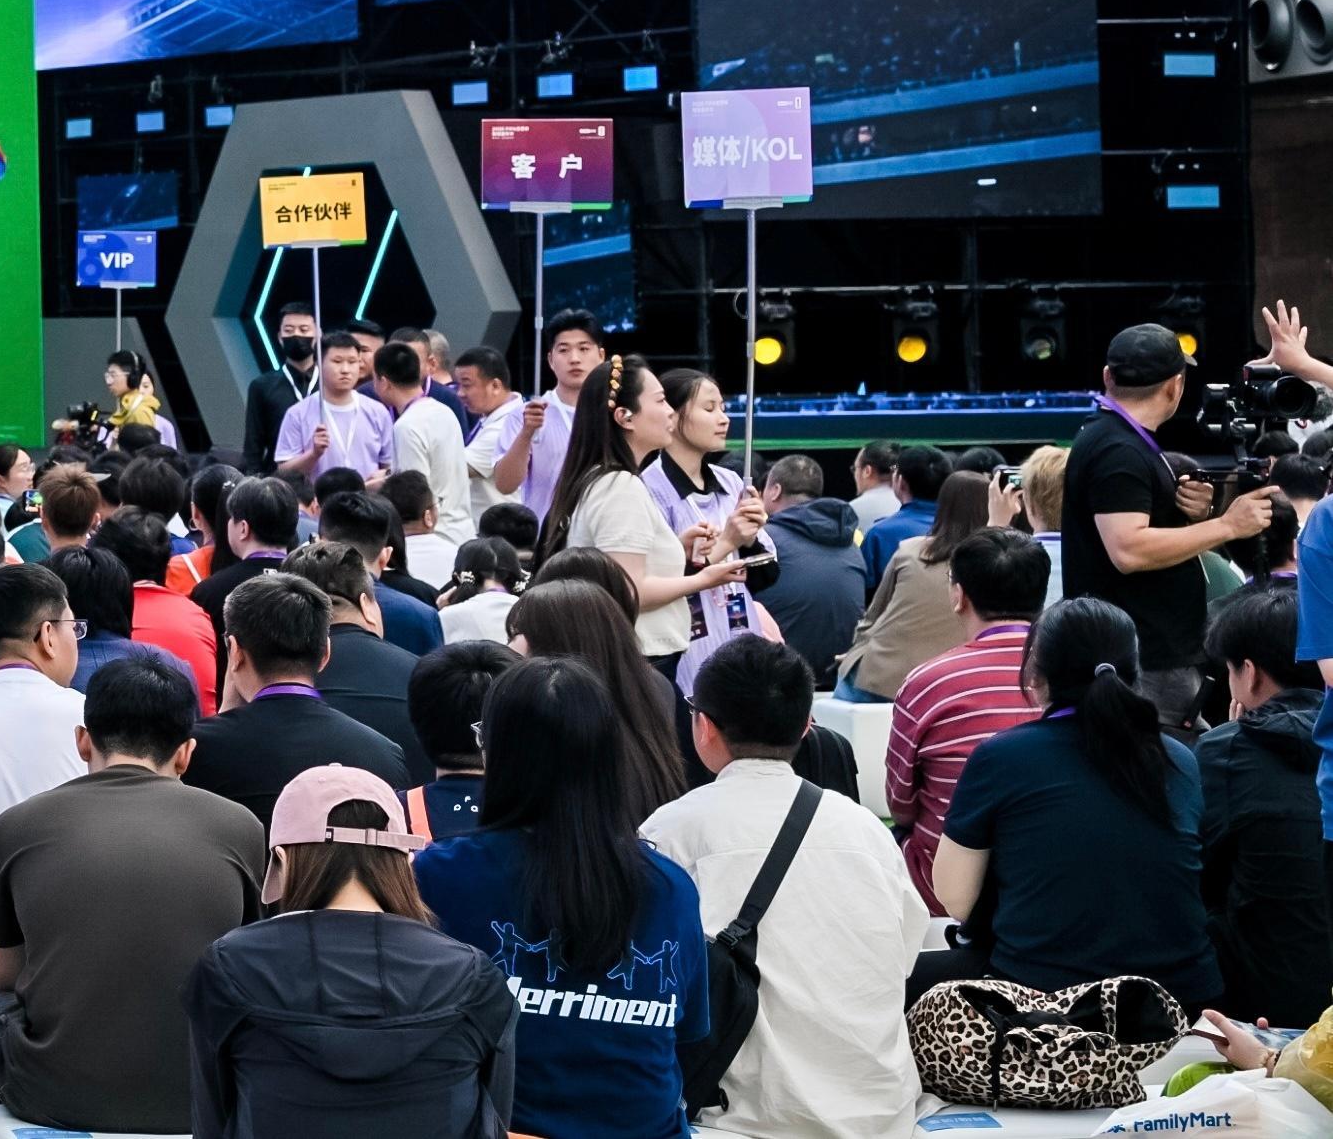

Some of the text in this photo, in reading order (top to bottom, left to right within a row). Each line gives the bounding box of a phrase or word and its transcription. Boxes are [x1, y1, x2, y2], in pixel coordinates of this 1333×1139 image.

[693, 135, 802, 168] 媒体/KOL
[275, 202, 352, 223] 合作伙伴
[99, 252, 134, 269] VIP
[1134, 1112, 1232, 1133] FamilyMart
